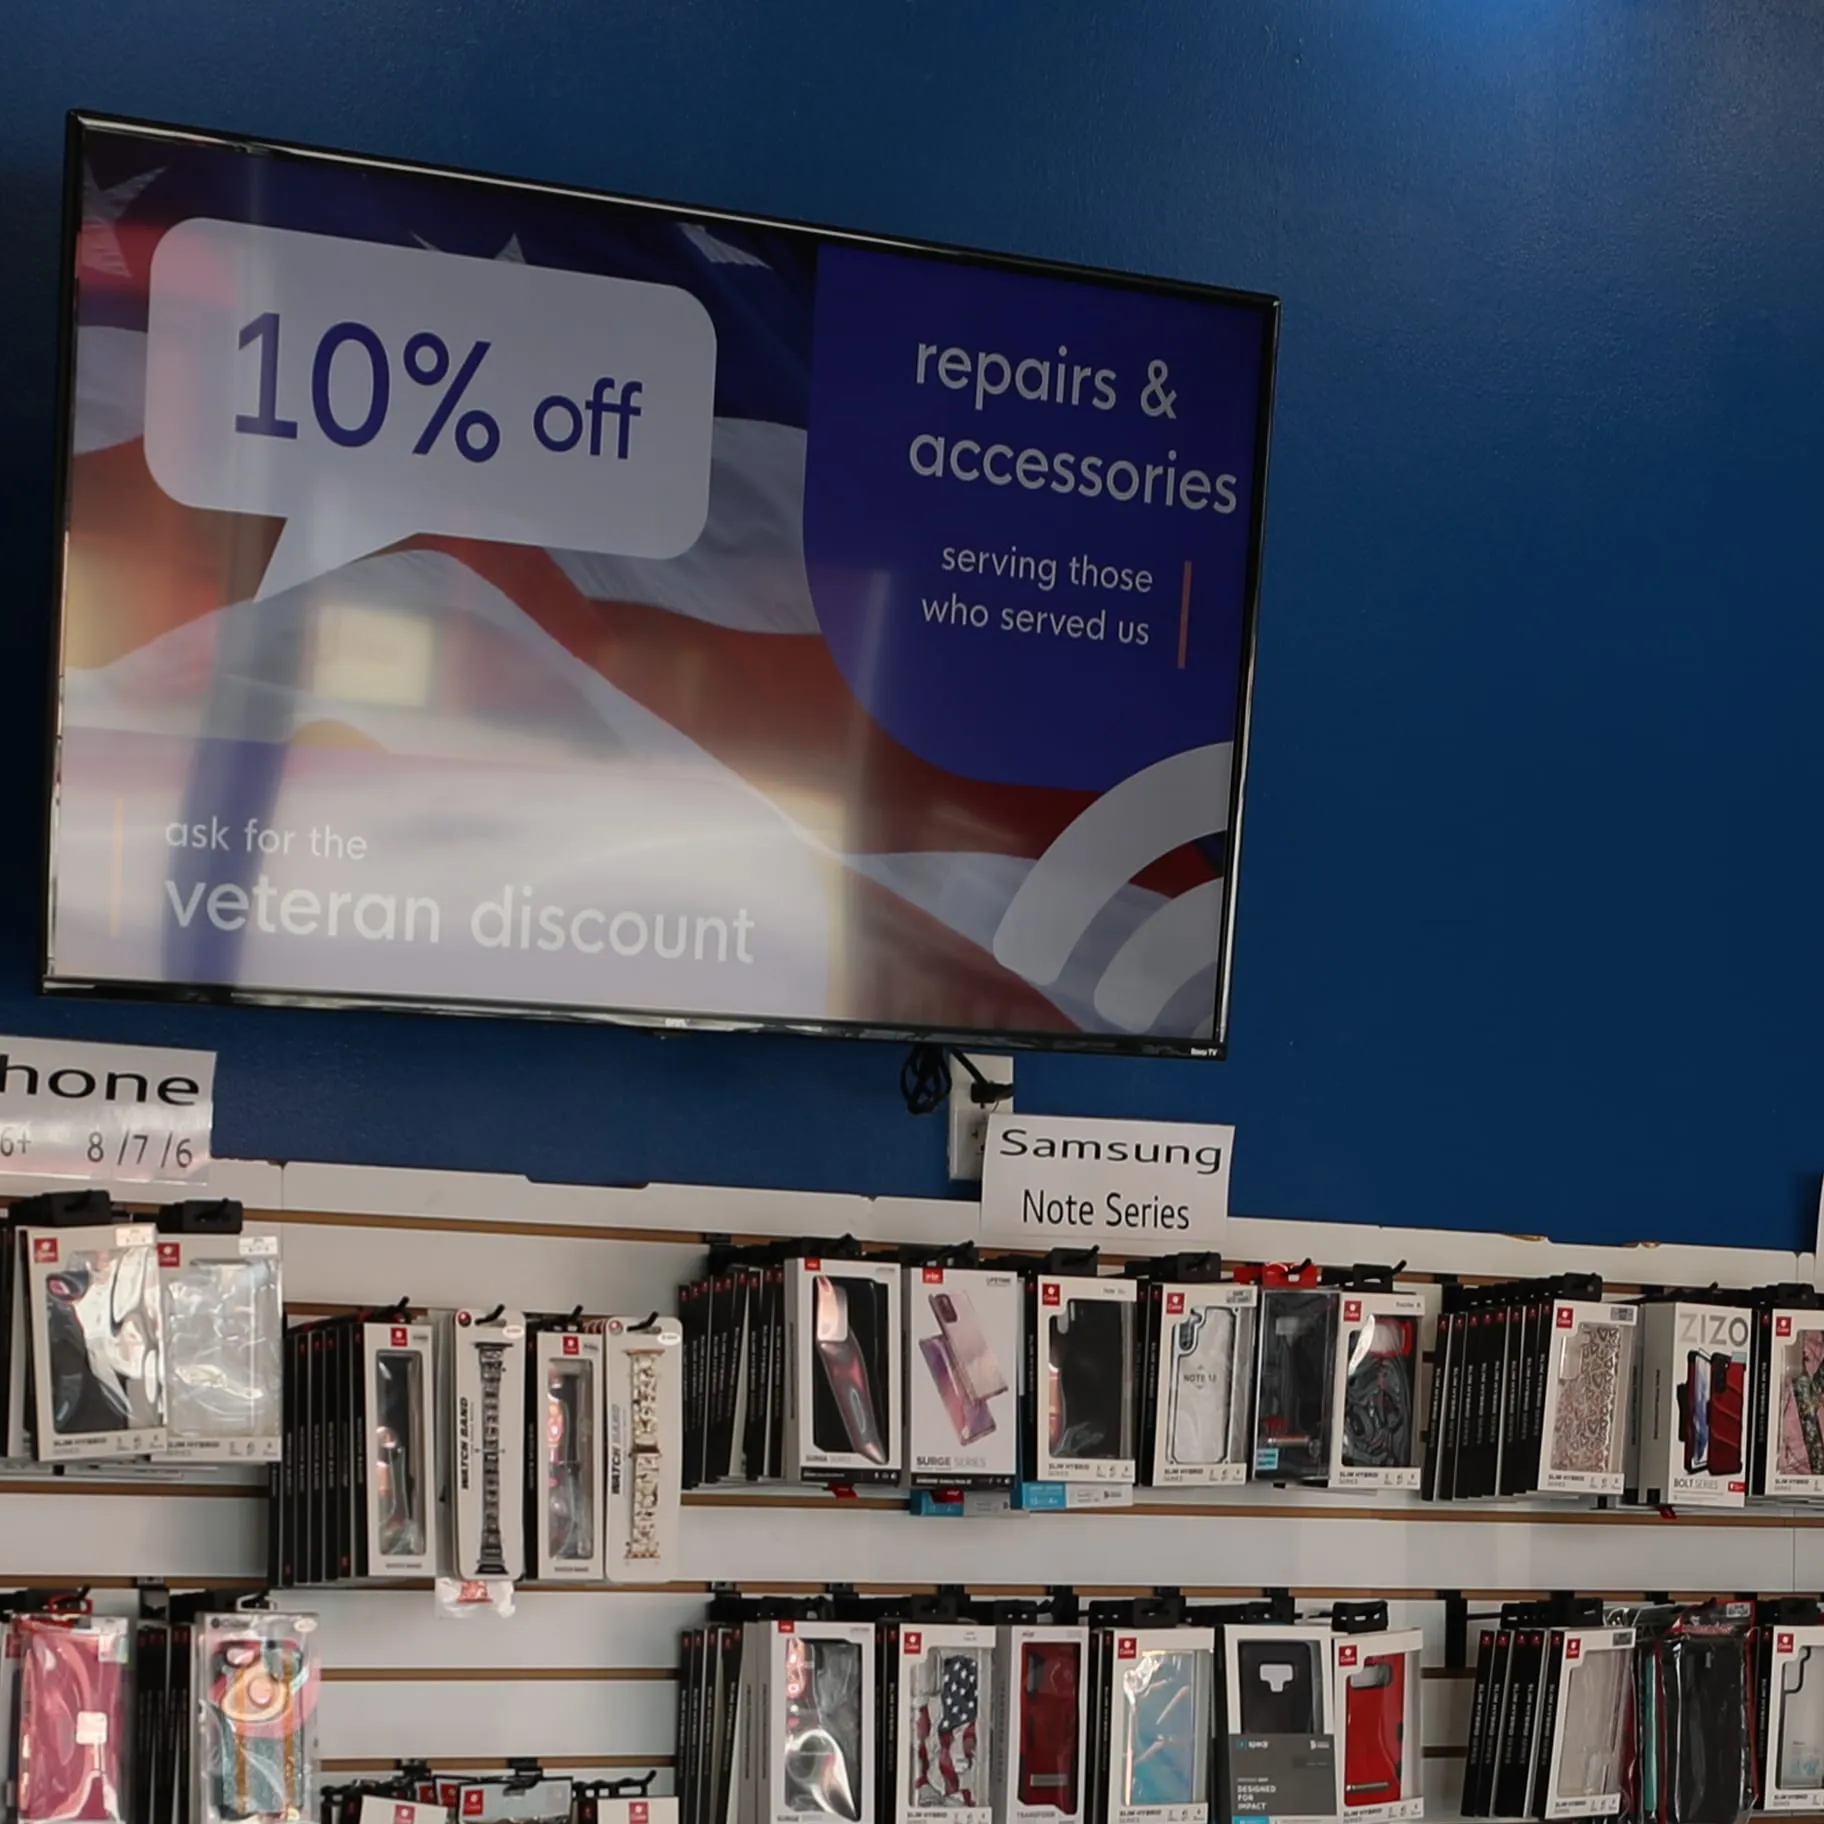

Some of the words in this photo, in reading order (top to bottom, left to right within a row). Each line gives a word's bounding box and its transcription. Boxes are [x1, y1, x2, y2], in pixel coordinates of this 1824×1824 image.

[232, 311, 501, 464] 10%
[532, 377, 643, 461] off
[915, 337, 1116, 413] repairs
[1140, 360, 1180, 418] &
[908, 430, 1239, 517] accessories
[940, 544, 1057, 591] serving
[1067, 557, 1154, 595] those
[920, 592, 989, 629] who
[999, 603, 1105, 641] served
[1116, 617, 1150, 647] us
[163, 814, 229, 852] ask
[237, 819, 300, 855] for
[308, 827, 369, 862] the
[163, 877, 443, 945] veteran
[470, 887, 756, 966] discount
[87, 1131, 105, 1163] 8
[999, 1128, 1223, 1175] Samsung
[1023, 1189, 1094, 1226] Note
[1106, 1192, 1190, 1230] Series
[1678, 1313, 1749, 1347] ZIZO
[1673, 1478, 1693, 1488] BOLT
[1237, 1784, 1276, 1794] DESIGNED
[1237, 1794, 1254, 1802] FOR
[1237, 1802, 1268, 1811] IMPACT
